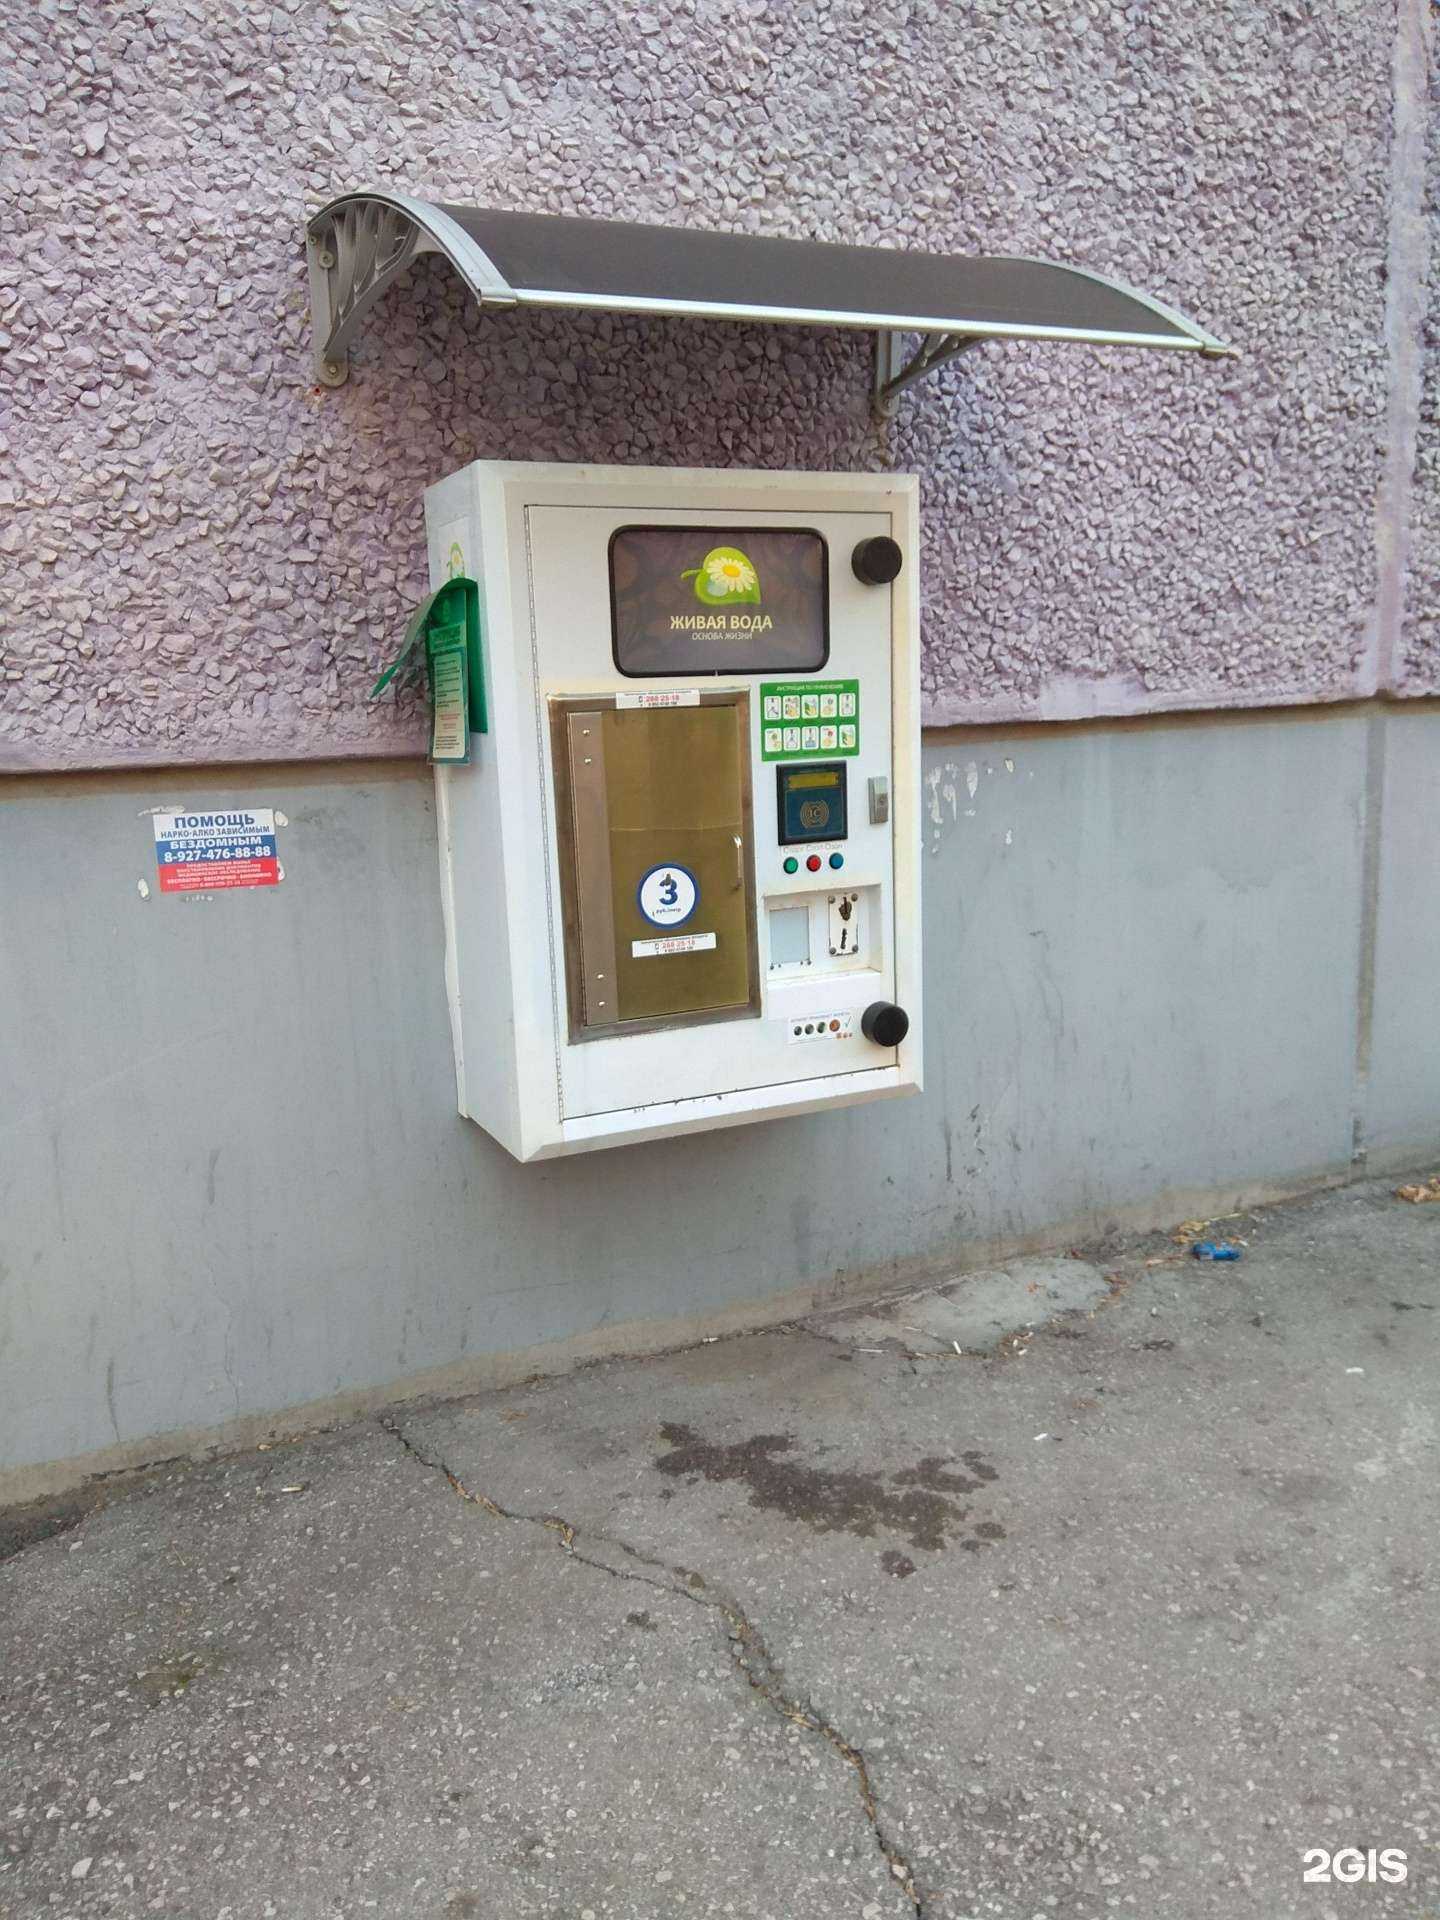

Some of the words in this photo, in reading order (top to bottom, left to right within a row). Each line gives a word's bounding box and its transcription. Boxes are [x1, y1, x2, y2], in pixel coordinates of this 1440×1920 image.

[670, 615, 726, 630] ЖИВАЯ
[730, 615, 773, 632] ВОДА
[691, 632, 723, 640] ОСНОВА
[724, 631, 753, 640] ЖИЗНИ
[174, 814, 255, 829] ПОМОЩЬ
[217, 825, 271, 836] ЗАВИСИМЫМ
[170, 836, 262, 850] БЕЗДОМНЫМ
[164, 845, 271, 863] 8-927-476-88-88
[659, 878, 678, 905] 3
